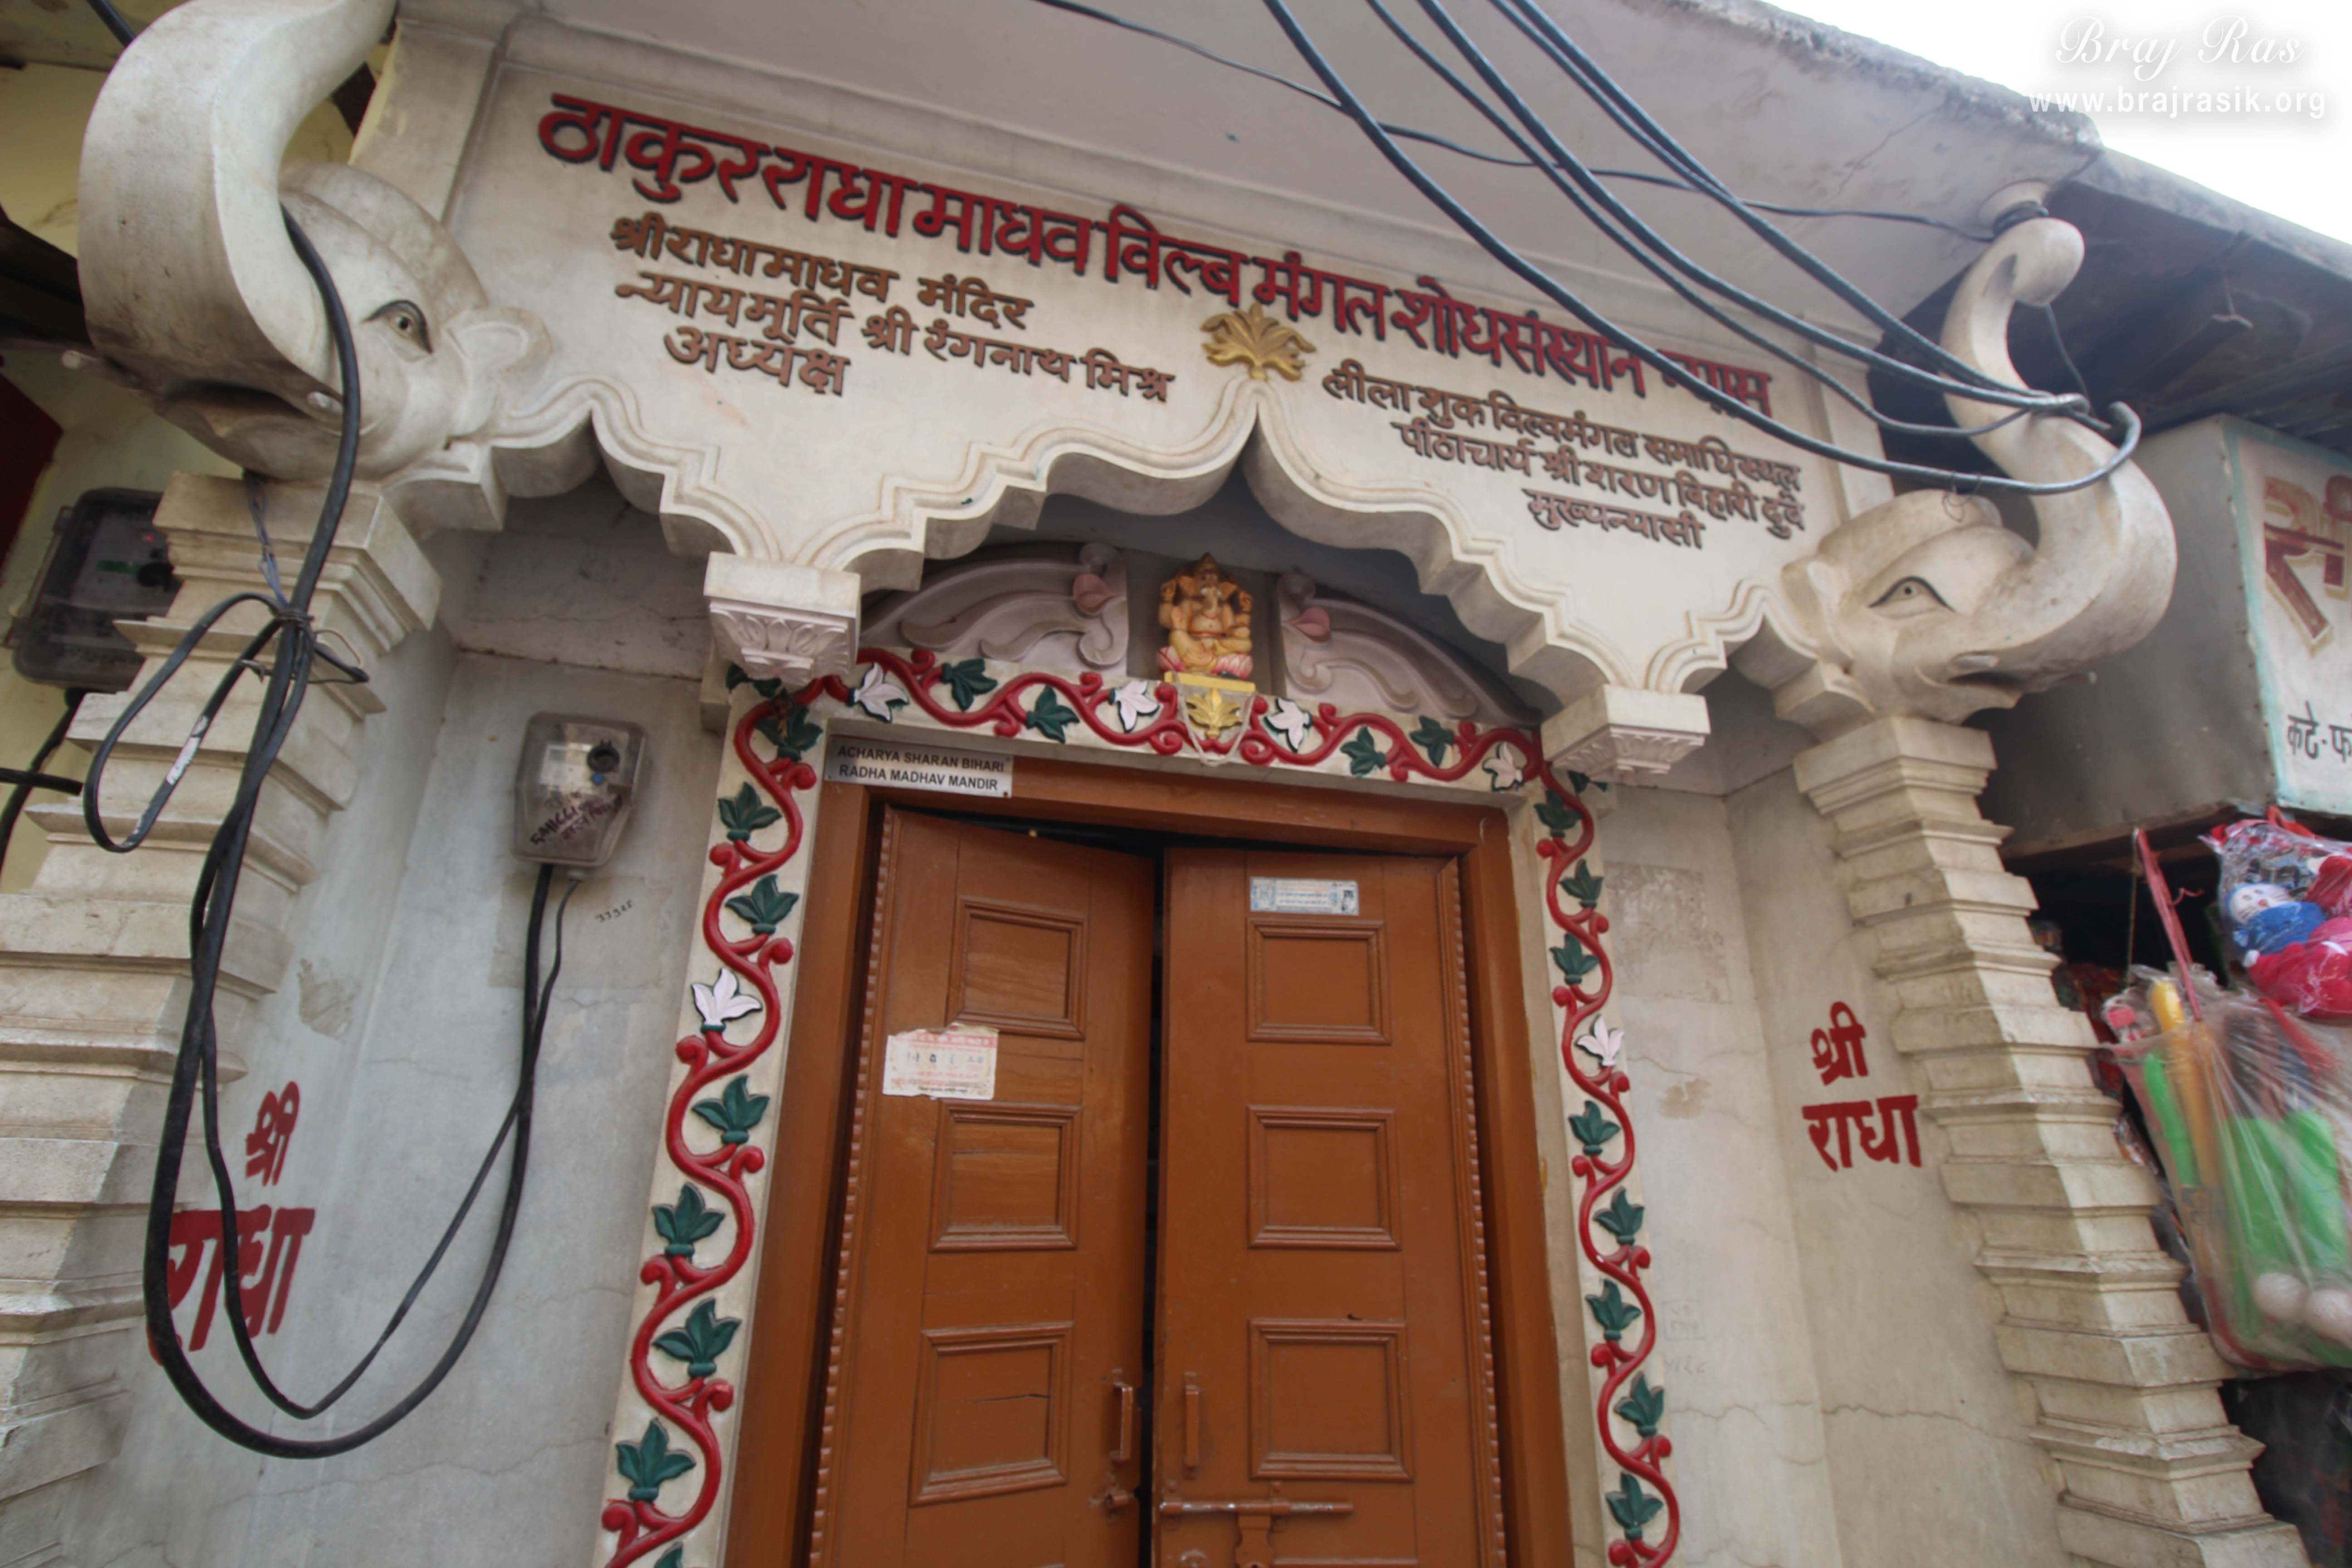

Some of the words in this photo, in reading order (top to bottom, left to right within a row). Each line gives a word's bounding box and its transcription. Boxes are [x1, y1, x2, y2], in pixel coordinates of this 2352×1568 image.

[664, 325, 851, 397] अध्यक्ष
[860, 304, 920, 356] श्री
[837, 745, 900, 763] ACHARYA
[903, 751, 958, 769] SHARAN
[961, 757, 1004, 772] BIHARI
[839, 764, 887, 780] RADHA
[890, 769, 945, 786] MADHAV
[948, 774, 998, 791] MANDIR
[1810, 1001, 1869, 1086] श्री
[245, 1081, 300, 1187] श्री
[1802, 1094, 1922, 1172] राधा
